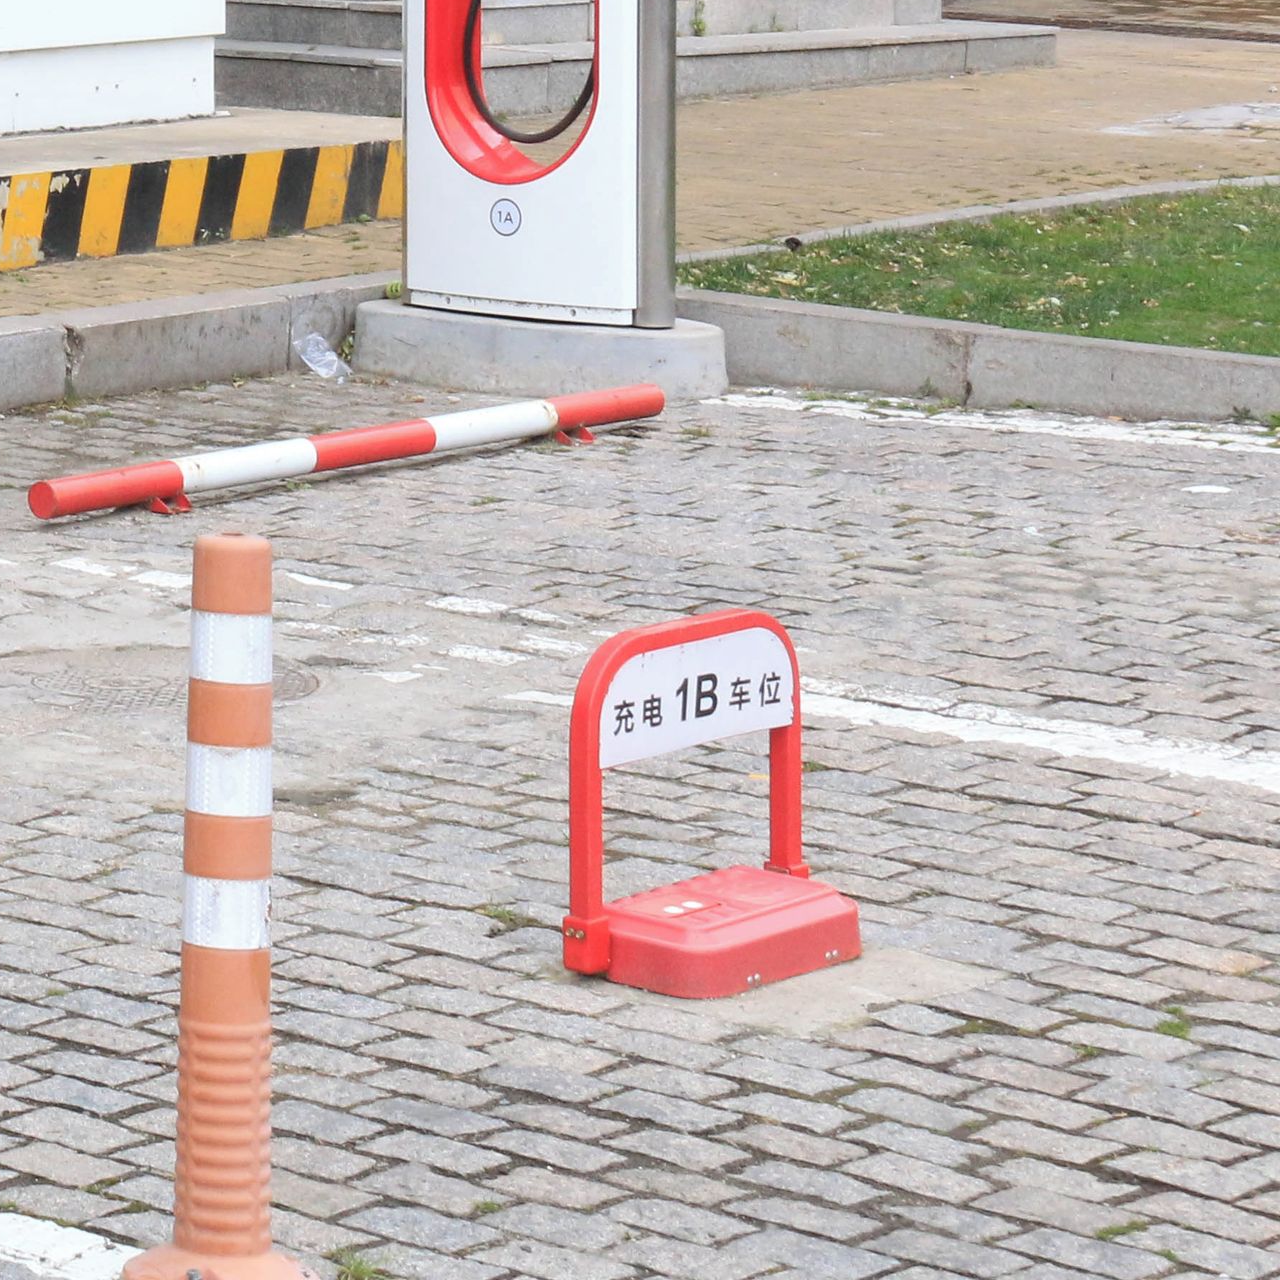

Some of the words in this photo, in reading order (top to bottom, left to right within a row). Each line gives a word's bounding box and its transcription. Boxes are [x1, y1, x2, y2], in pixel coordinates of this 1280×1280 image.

[496, 209, 514, 226] 1A
[613, 693, 663, 736] 充电
[675, 672, 719, 722] 1B
[728, 671, 782, 711] 车位
